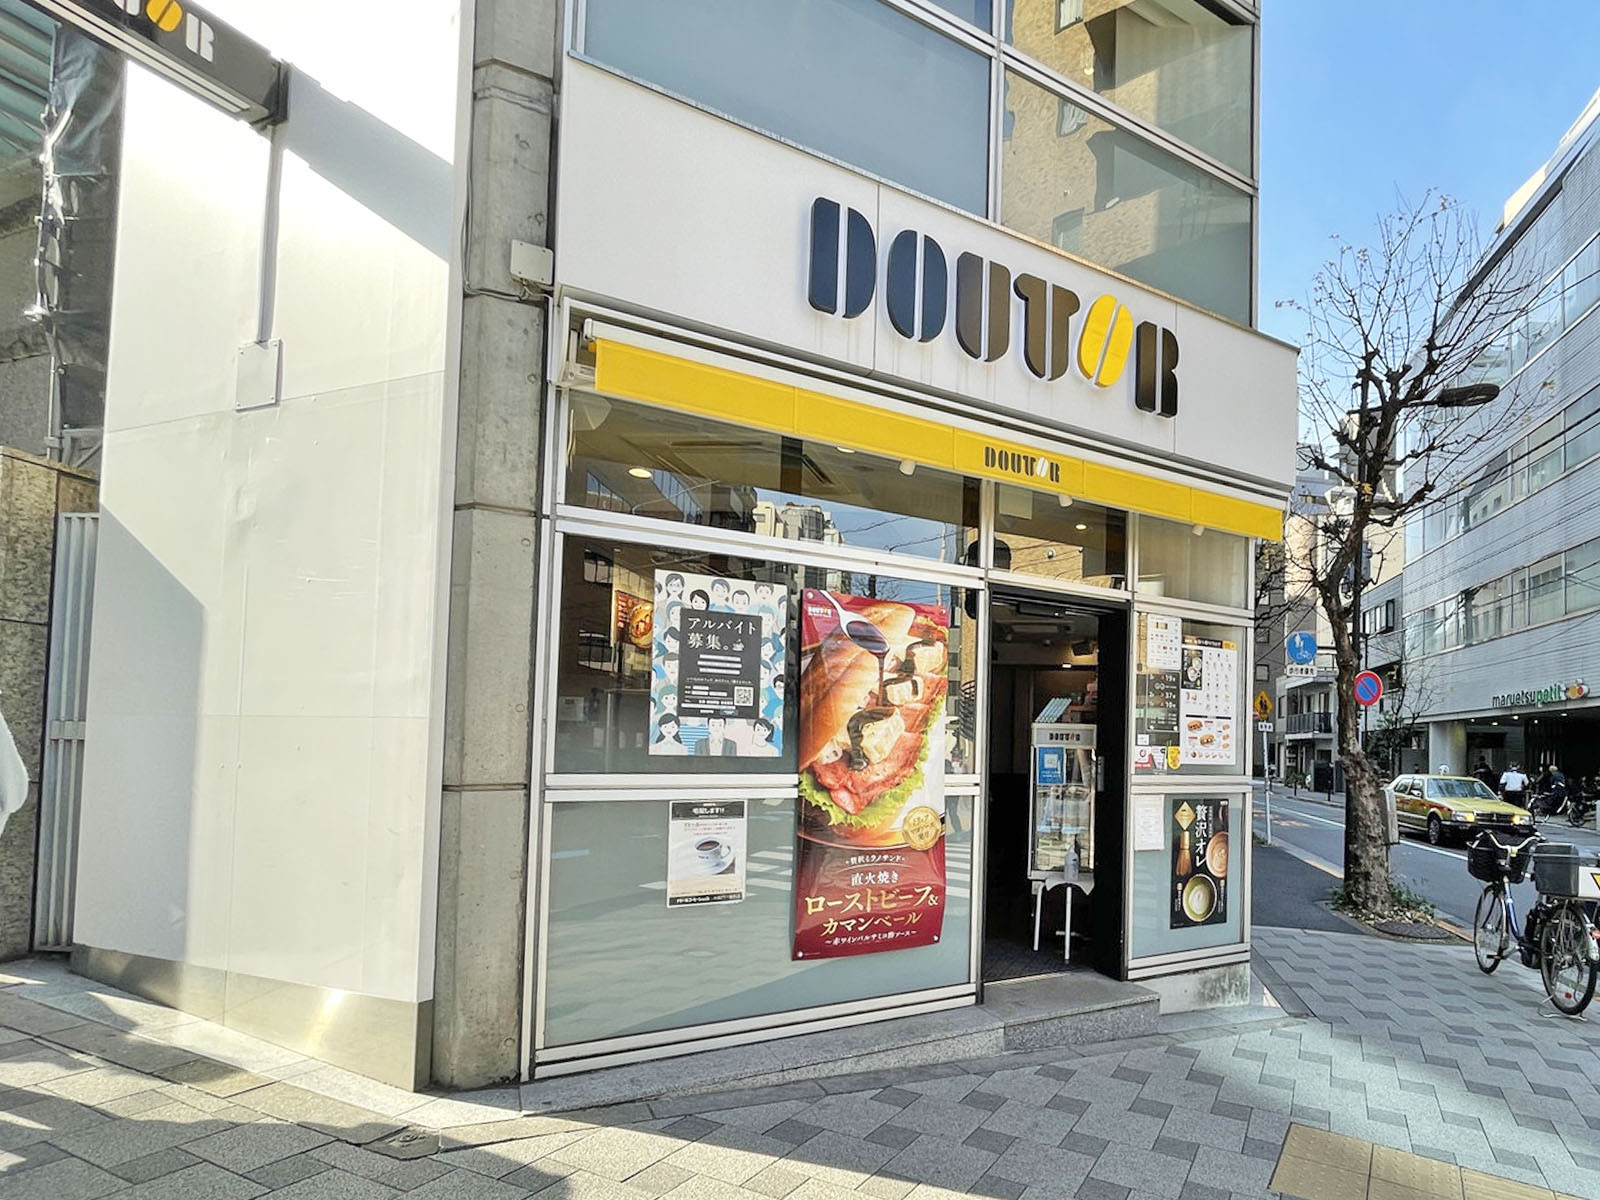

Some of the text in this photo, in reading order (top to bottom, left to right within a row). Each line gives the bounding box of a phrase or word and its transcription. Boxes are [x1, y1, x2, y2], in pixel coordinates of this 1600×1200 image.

[807, 196, 1180, 418] DOUTOR
[984, 445, 1061, 483] DOUTOR
[687, 616, 757, 636] アルバイト
[851, 870, 899, 887] 直火焼き
[820, 911, 924, 937] カマンベール
